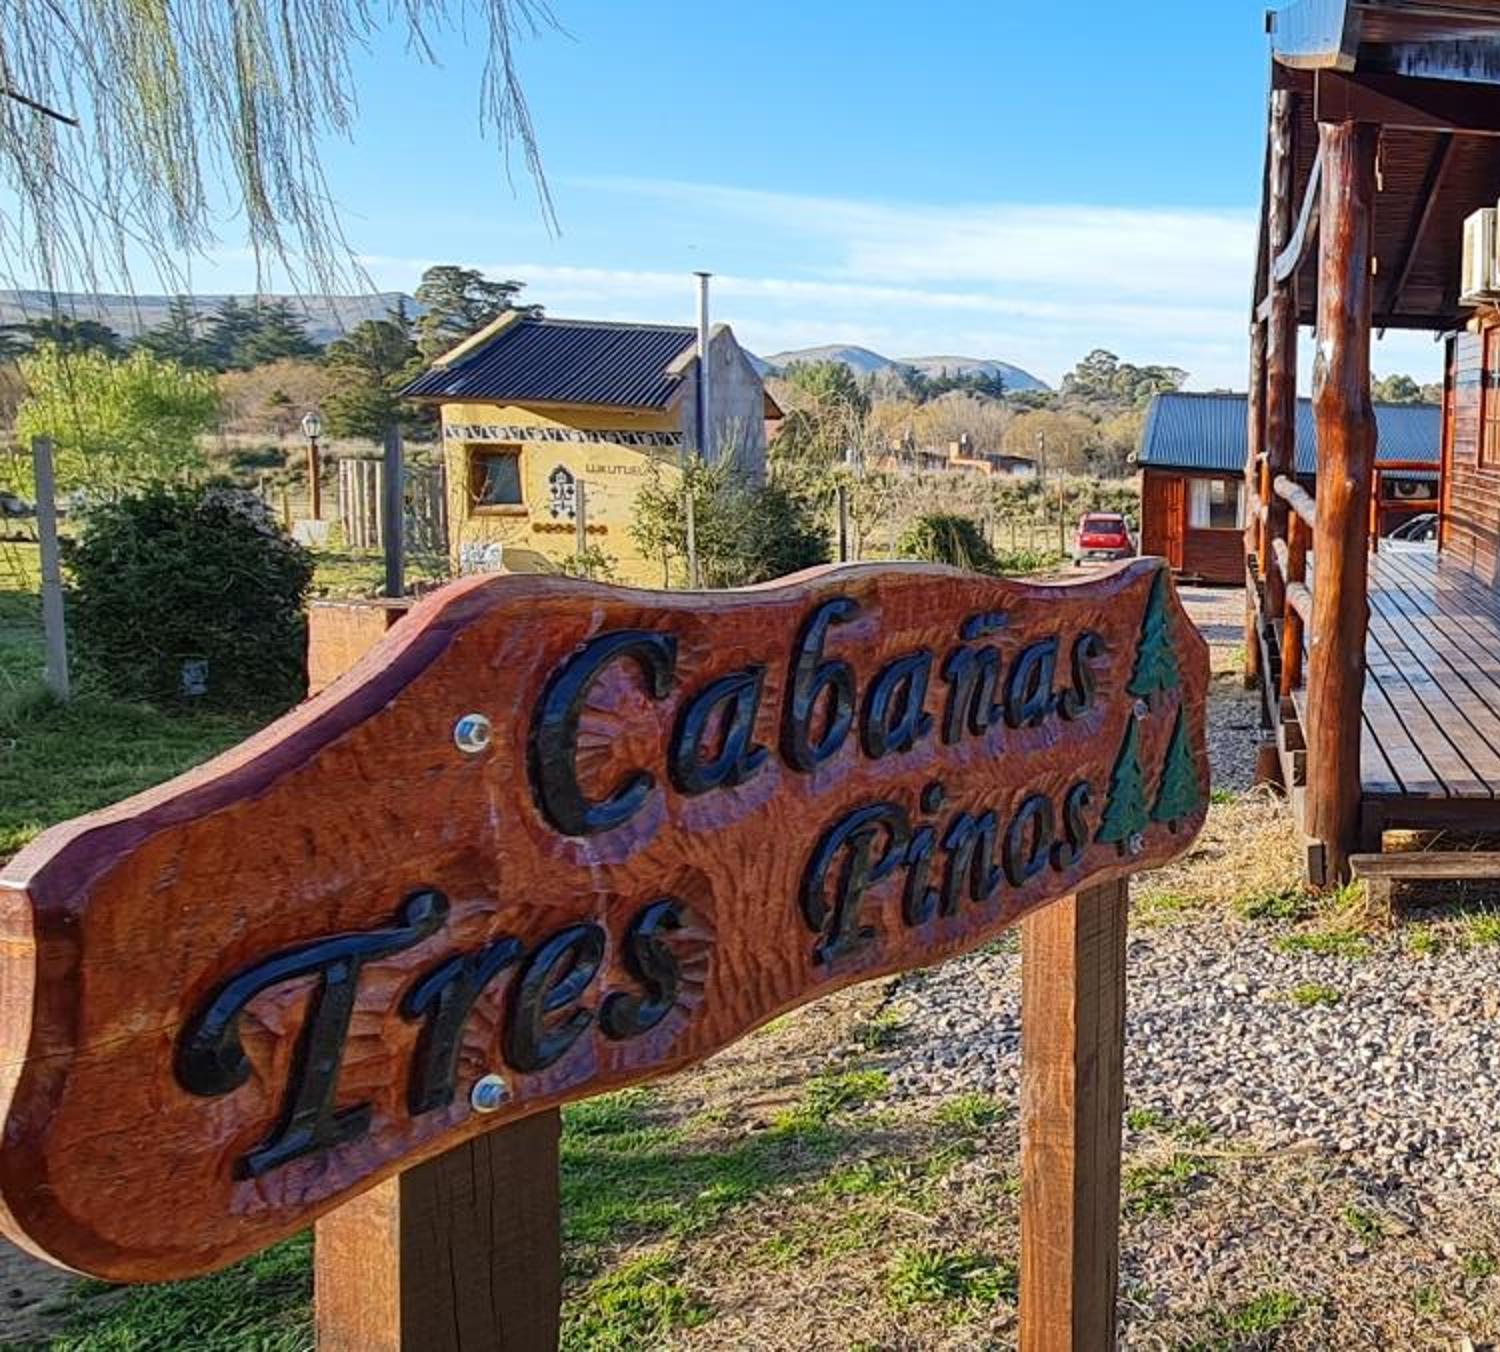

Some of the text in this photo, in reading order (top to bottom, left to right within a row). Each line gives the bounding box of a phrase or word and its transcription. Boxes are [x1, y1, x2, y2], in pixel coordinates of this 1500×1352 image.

[526, 597, 1107, 836] Cabañas
[173, 779, 1092, 1181] Tres Pinos
